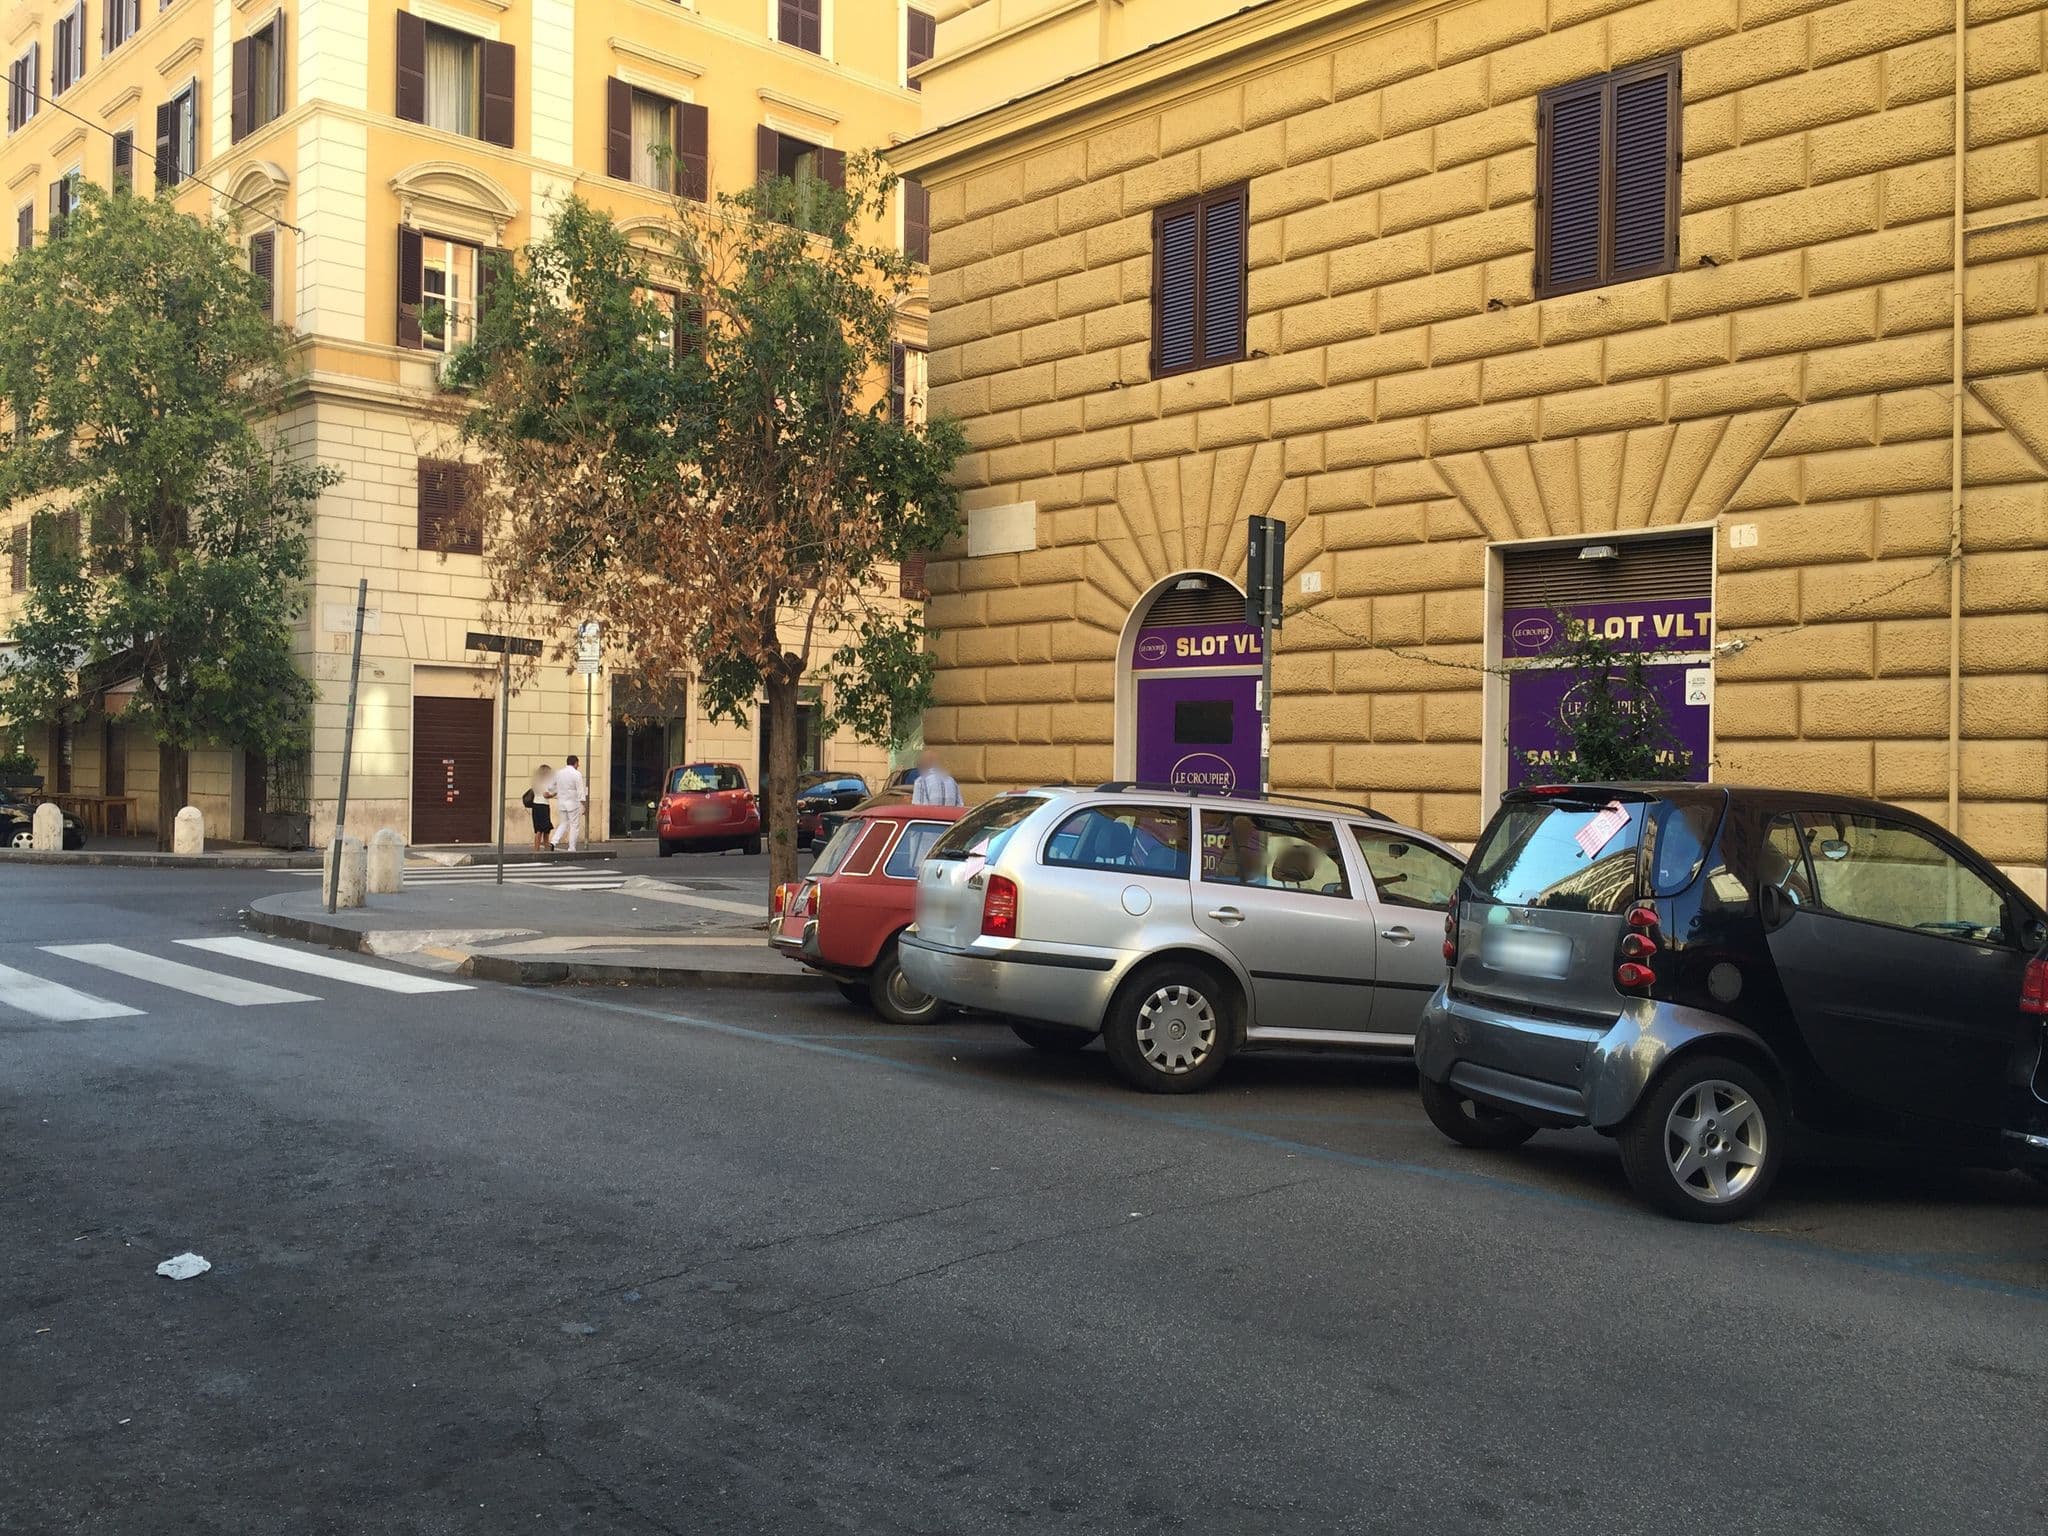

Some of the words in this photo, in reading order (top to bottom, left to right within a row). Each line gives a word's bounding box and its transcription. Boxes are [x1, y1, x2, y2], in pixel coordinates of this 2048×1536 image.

[1652, 612, 1711, 638] VLT
[1176, 635, 1228, 657] SLOT
[1233, 634, 1263, 654] VL
[1175, 772, 1186, 784] LE
[1187, 772, 1230, 785] CROUPIER
